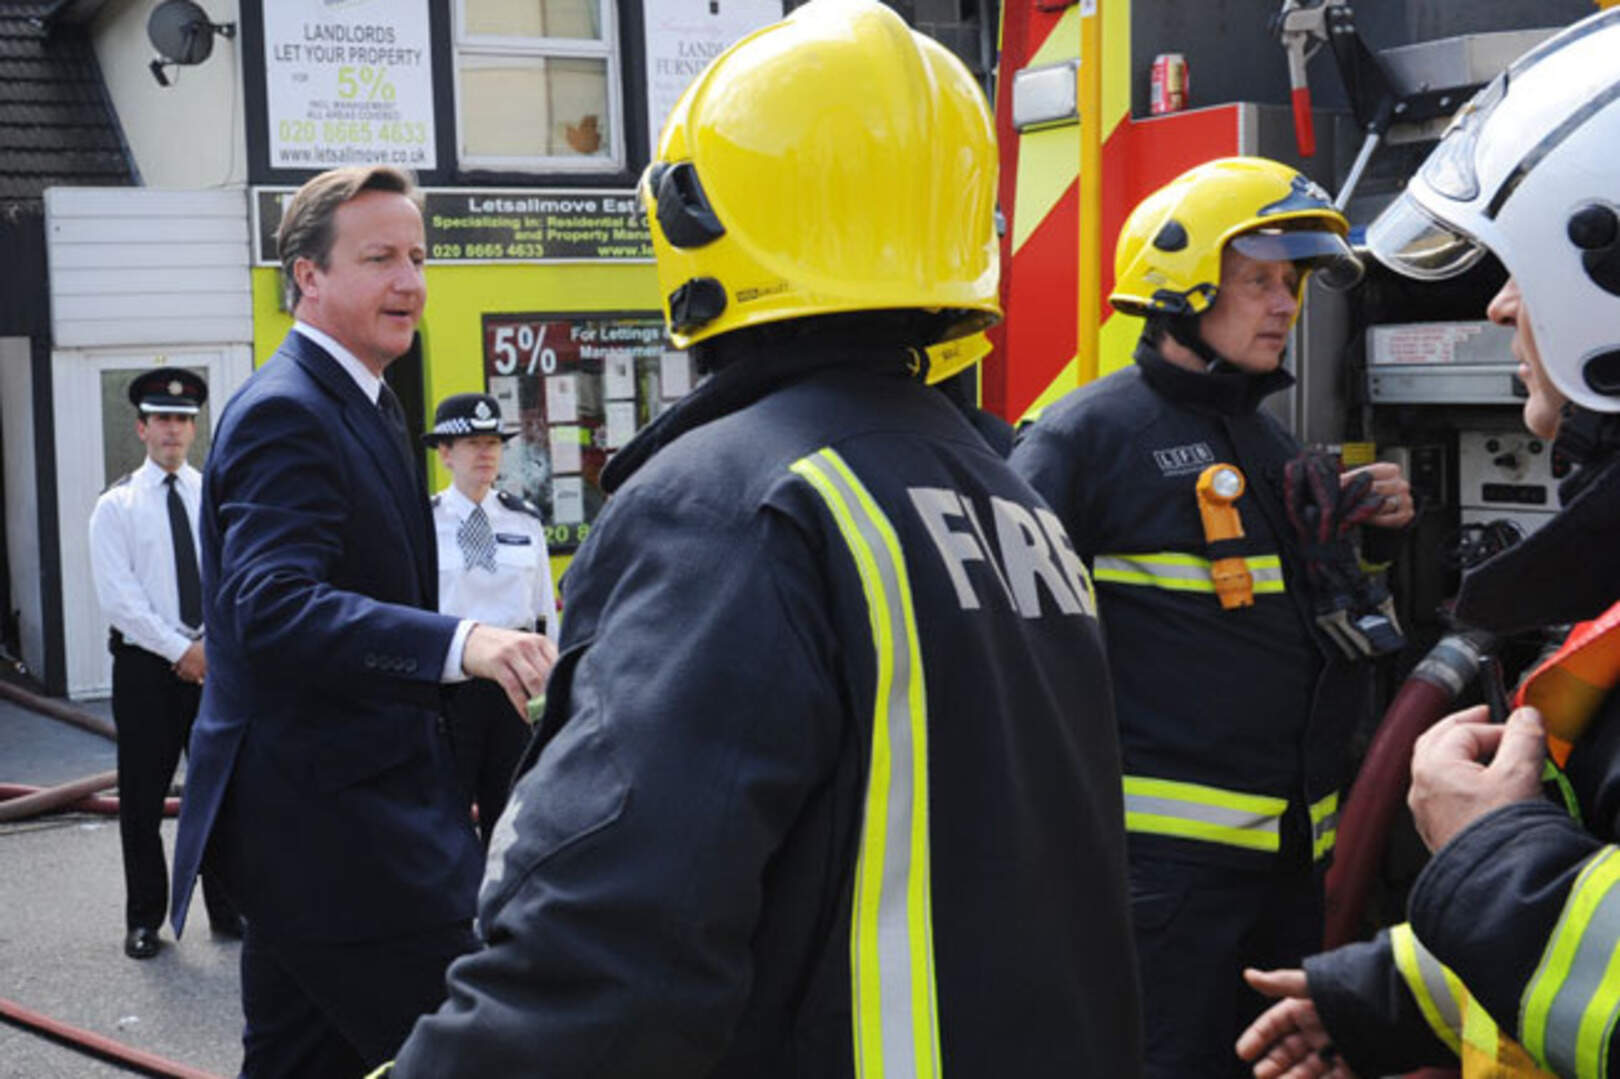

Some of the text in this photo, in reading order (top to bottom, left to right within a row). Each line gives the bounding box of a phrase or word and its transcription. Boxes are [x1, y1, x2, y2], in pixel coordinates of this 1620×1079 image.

[303, 24, 396, 43] LANDLORDS
[274, 44, 422, 65] LET YOUR PROPERTY
[678, 41, 731, 58] LAND
[656, 59, 707, 75] FURNI
[337, 66, 396, 100] 5%
[279, 119, 425, 144] 020 8665 4633
[279, 145, 424, 162] www.letsallmove.co.uk
[468, 198, 597, 213] Letsallmove
[433, 215, 521, 231] Specializing
[548, 216, 624, 228] Residential
[515, 230, 542, 240] and
[548, 230, 608, 243] Property
[433, 244, 544, 257] 020 8665 4633
[570, 326, 597, 342] For
[600, 327, 659, 344] Lettings
[494, 326, 556, 375] 5%
[906, 487, 1098, 622] FIRE
